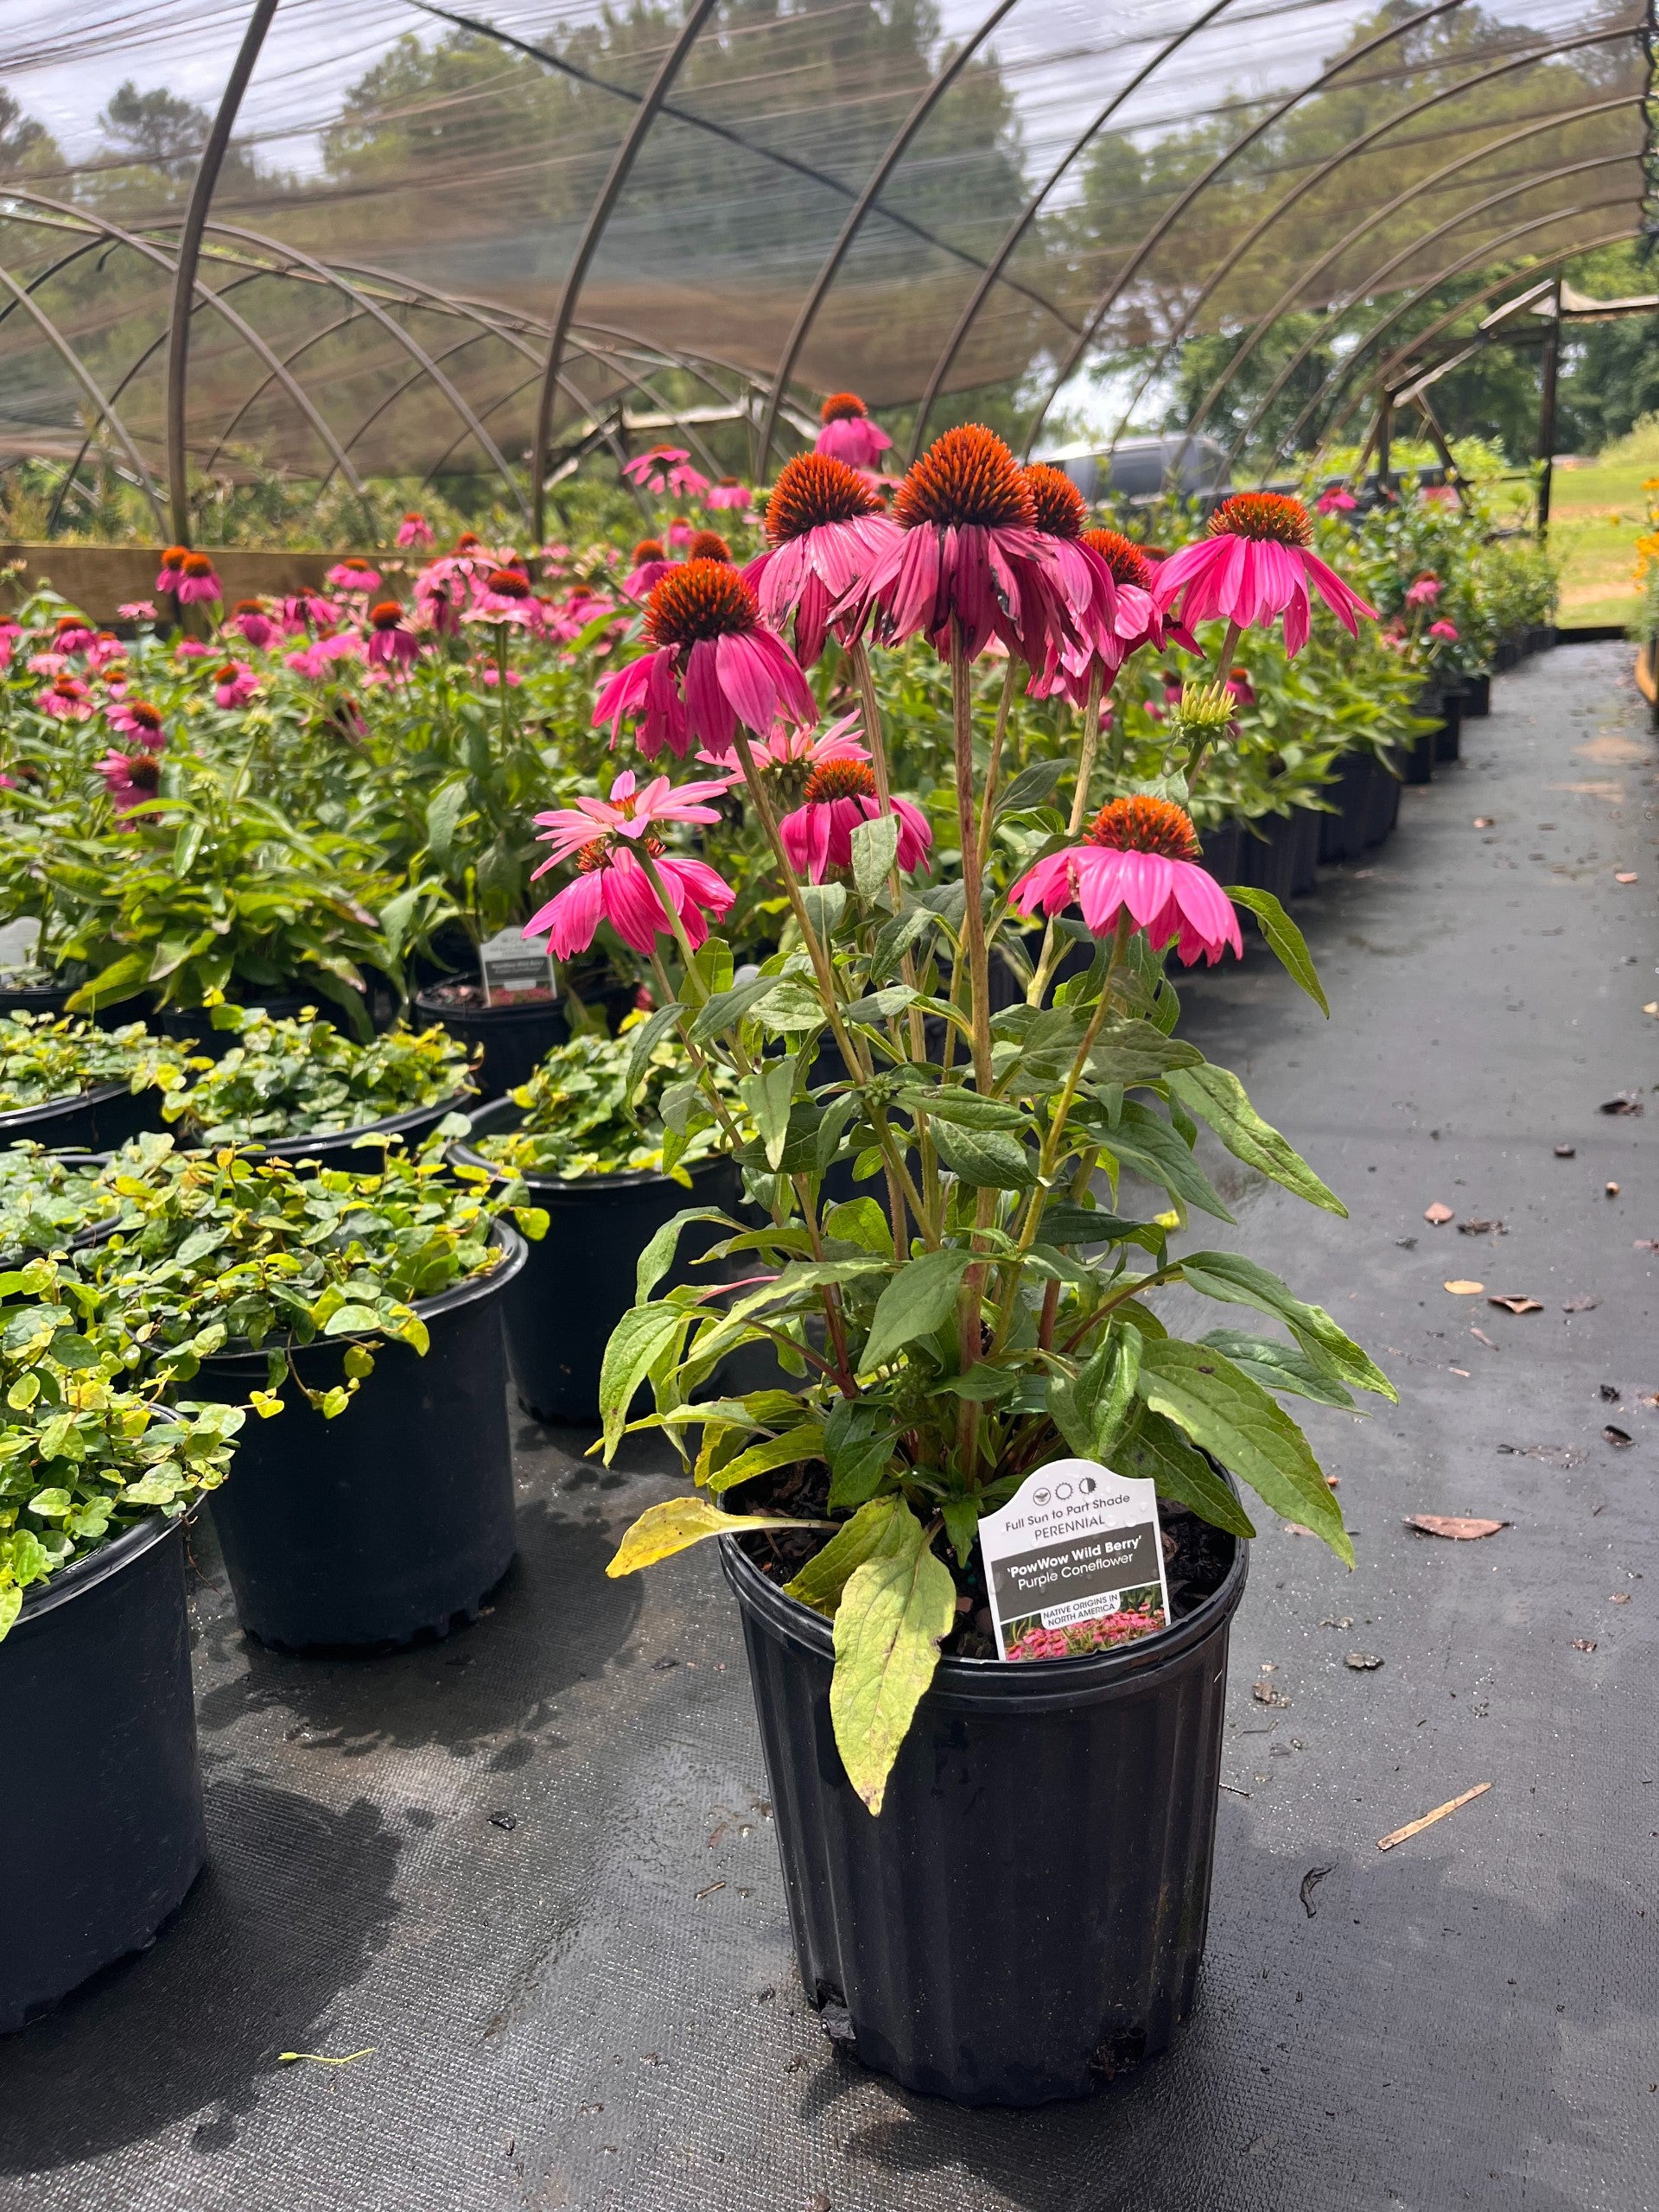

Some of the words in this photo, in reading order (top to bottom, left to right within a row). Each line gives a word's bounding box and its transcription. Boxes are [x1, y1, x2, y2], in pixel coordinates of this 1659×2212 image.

[1006, 1520, 1024, 1532] Full
[1028, 1514, 1048, 1525] Sun
[1052, 1510, 1063, 1519] to
[1066, 1502, 1090, 1516] Part
[1093, 1495, 1130, 1509] Shade
[1035, 1516, 1104, 1540] PERENNIAL
[1071, 1545, 1101, 1560] Wild
[1018, 1573, 1058, 1590] Purple
[1061, 1552, 1134, 1578] Coneflower
[1043, 1606, 1071, 1619] NATIVE
[1072, 1597, 1107, 1611] ORIGINS
[1048, 1613, 1076, 1627] NORTH
[1078, 1604, 1115, 1619] AMERICA
